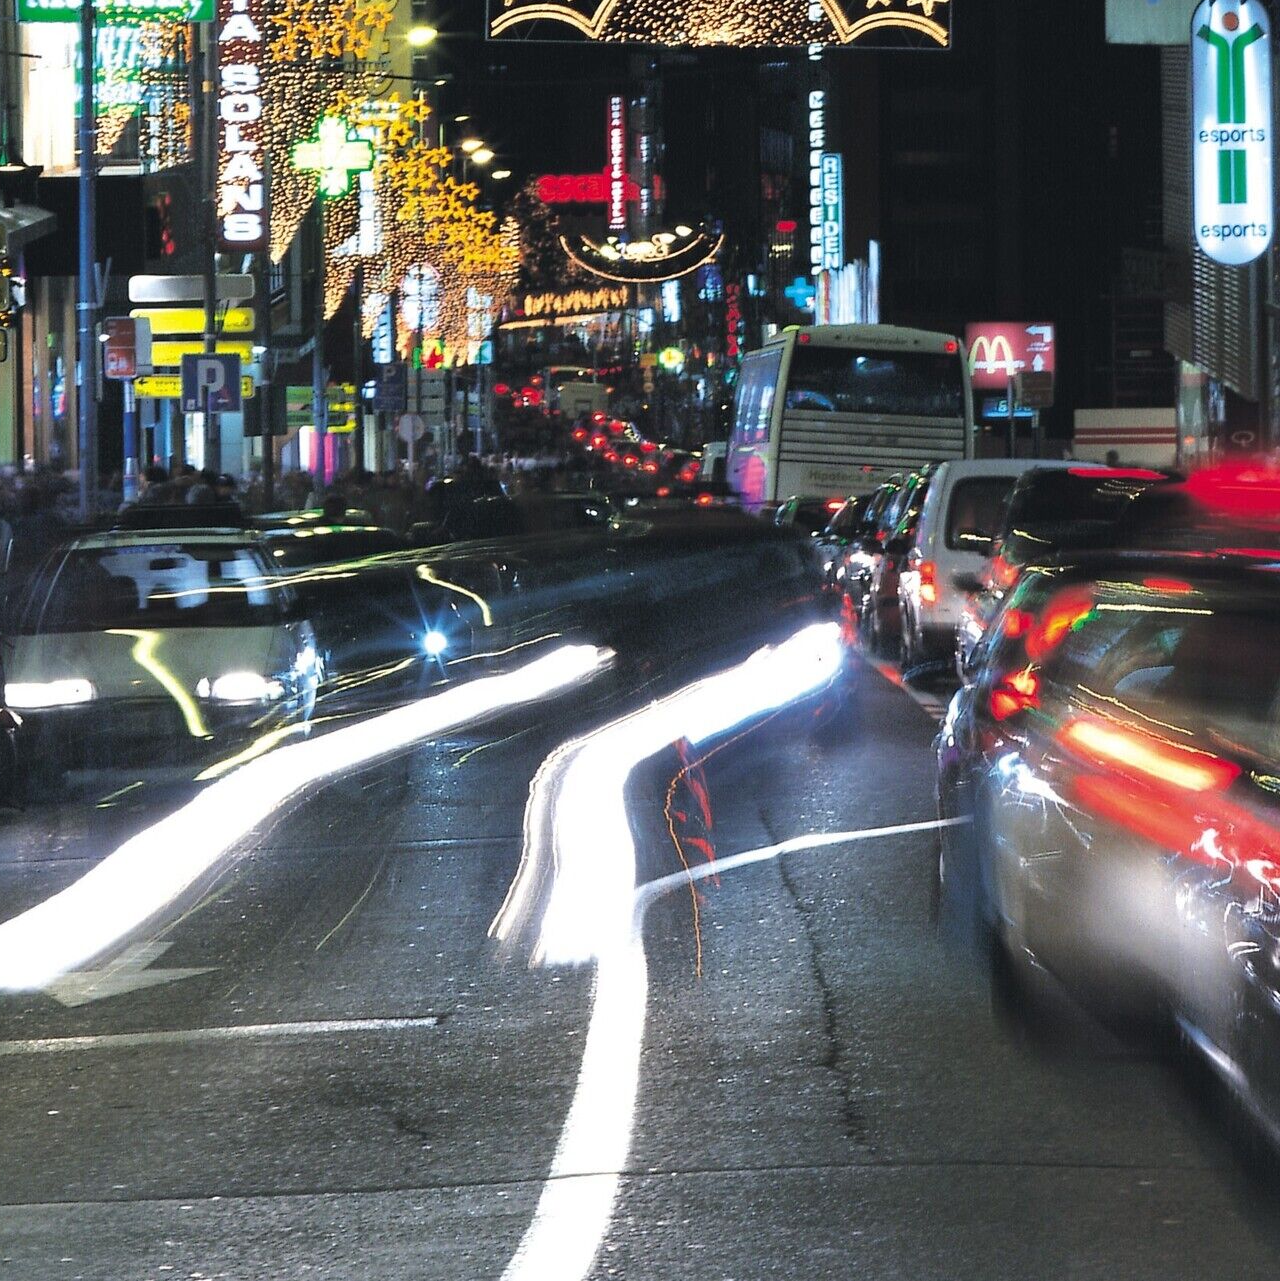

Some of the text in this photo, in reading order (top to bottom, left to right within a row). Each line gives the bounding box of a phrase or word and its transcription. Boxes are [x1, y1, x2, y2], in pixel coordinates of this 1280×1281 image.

[219, 64, 262, 243] SOLANS
[1198, 124, 1266, 147] esports
[823, 156, 840, 269] RESIDEN
[1200, 218, 1267, 242] esports
